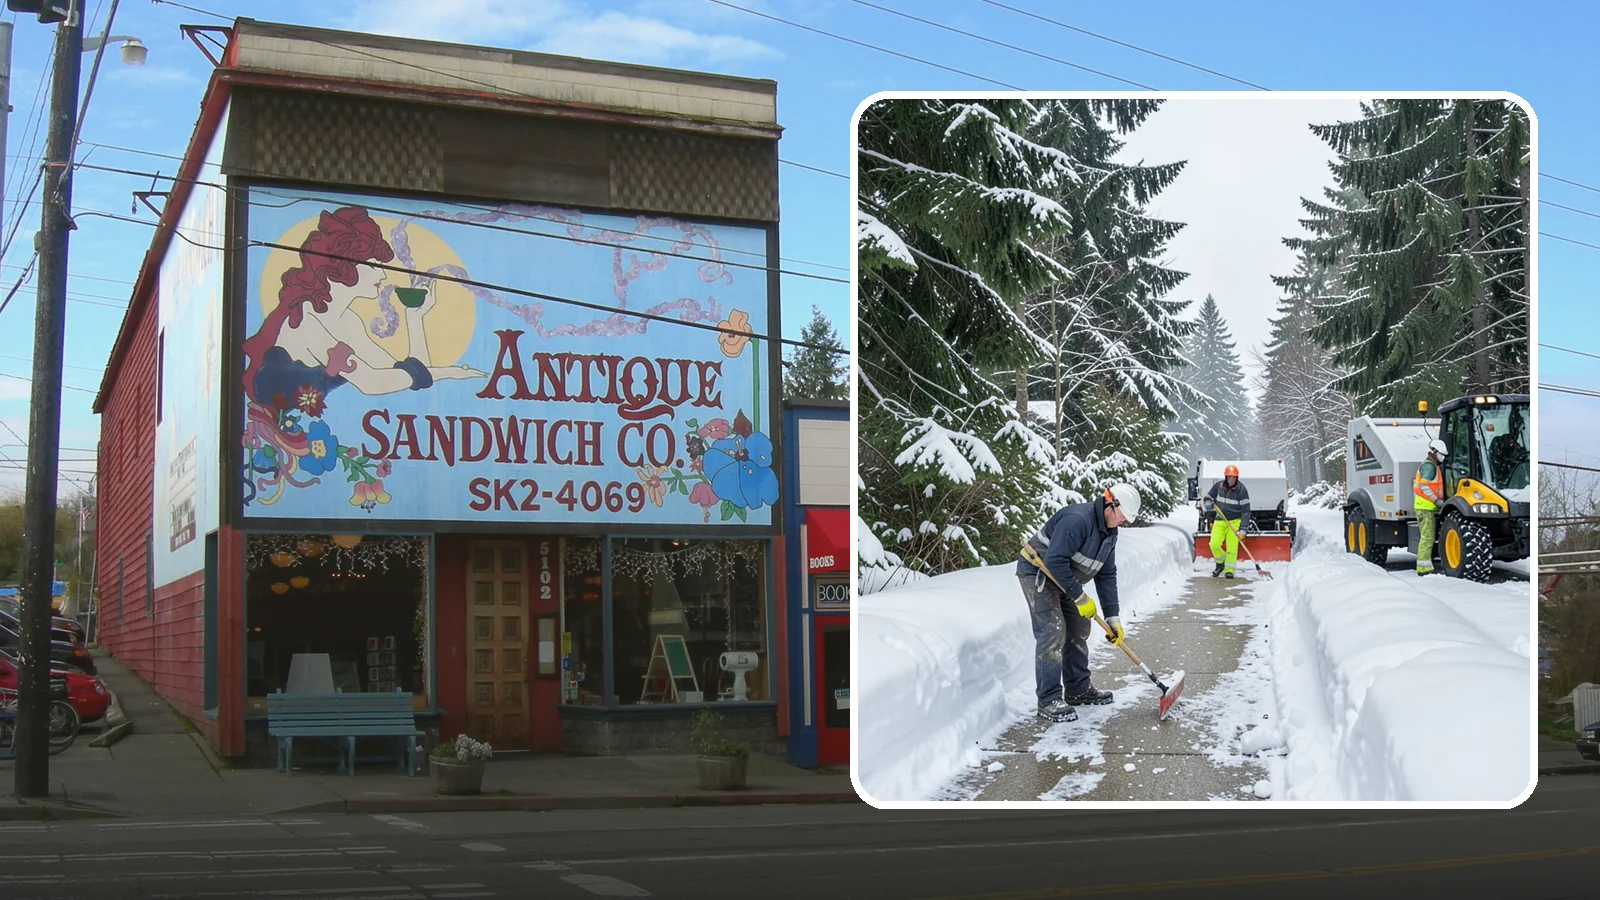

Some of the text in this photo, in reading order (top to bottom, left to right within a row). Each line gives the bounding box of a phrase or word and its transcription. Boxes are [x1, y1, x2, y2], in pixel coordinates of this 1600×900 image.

[361, 408, 685, 469] SANDWICH CO.
[468, 477, 646, 513] SK2-4069
[539, 541, 552, 600] 5102
[809, 555, 835, 569] BOOKS
